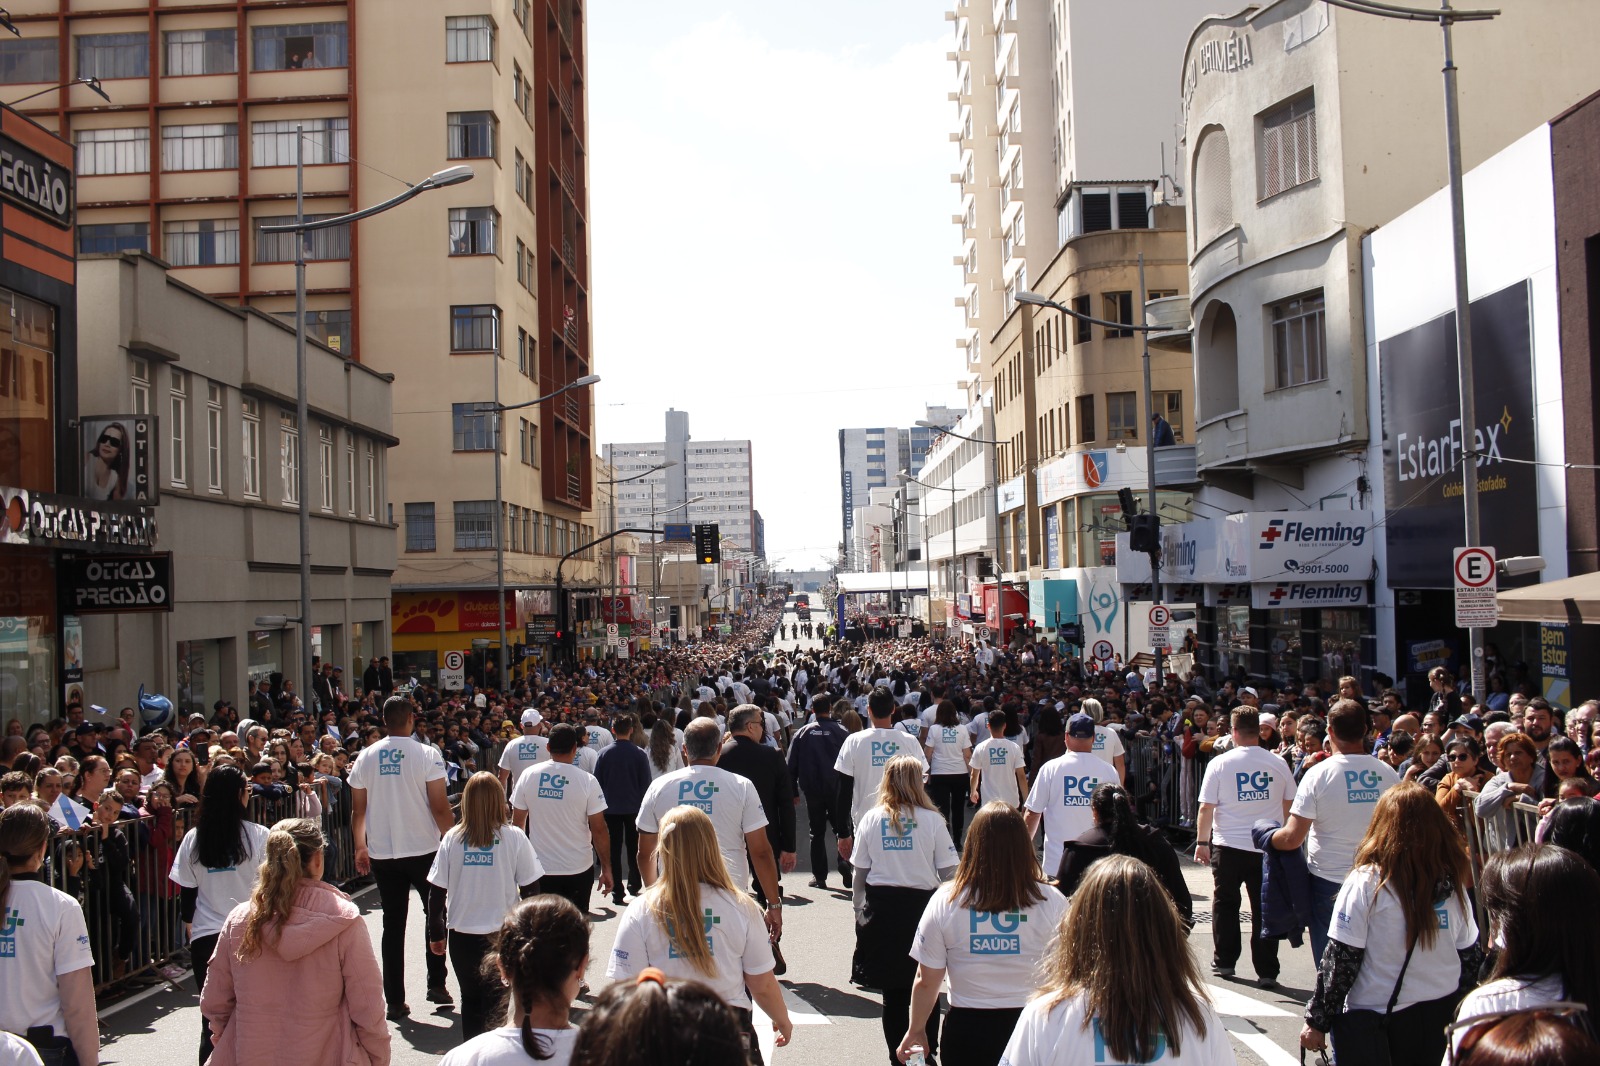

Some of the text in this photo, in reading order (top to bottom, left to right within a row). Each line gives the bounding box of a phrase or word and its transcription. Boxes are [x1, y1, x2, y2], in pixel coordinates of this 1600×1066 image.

[1200, 30, 1252, 75] CRIMÉIA
[0, 152, 67, 215] ECISÃO
[1397, 419, 1503, 482] EstarFex
[136, 421, 147, 500] ÓTICA
[1284, 521, 1366, 547] Fleming
[86, 560, 156, 581] ÓTICAS
[1299, 564, 1349, 574] 3901-5000
[1467, 556, 1482, 579] E
[76, 582, 166, 606] PRECISÃO
[1289, 583, 1362, 602] Fleming
[1155, 611, 1163, 622] E
[1541, 627, 1564, 646] Bem
[450, 656, 457, 667] E
[1541, 646, 1567, 665] Estar
[1542, 664, 1567, 676] EstarFlex
[380, 764, 400, 774] SAÚDE
[539, 788, 563, 799] SAÚDE
[1065, 794, 1091, 806] SAÚD
[1239, 790, 1269, 801] SAÚDE
[1349, 789, 1379, 802] SAÚDE
[883, 838, 912, 848] SAÚDE
[464, 852, 493, 865] SAÚDE
[973, 933, 1018, 952] SAÚDE
